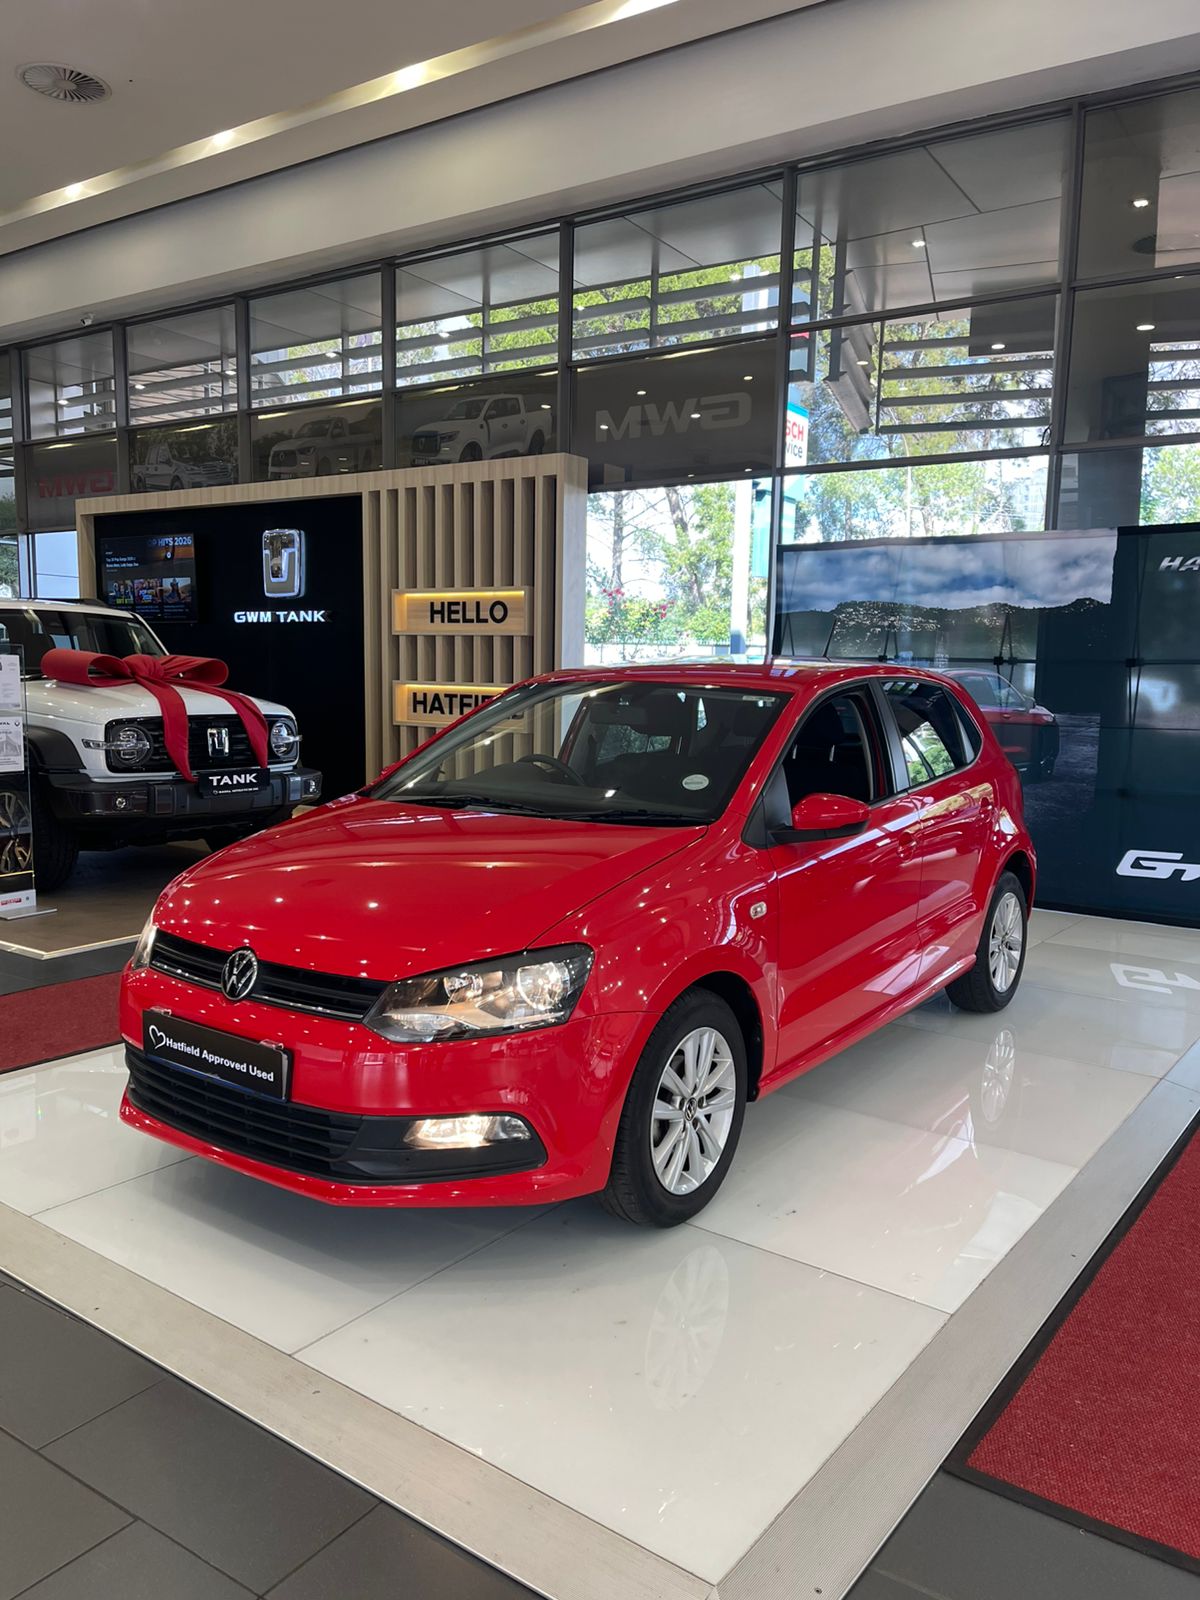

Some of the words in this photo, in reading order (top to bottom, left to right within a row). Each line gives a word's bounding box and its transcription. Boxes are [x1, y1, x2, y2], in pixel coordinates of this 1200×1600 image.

[234, 611, 271, 623] GWM
[276, 610, 325, 623] TANK
[430, 600, 509, 624] HELLO
[412, 692, 524, 719] HATFI
[208, 773, 258, 786] TANK
[166, 1036, 200, 1057] Hatfield
[201, 1049, 247, 1073] Approved
[249, 1064, 274, 1082] Used
